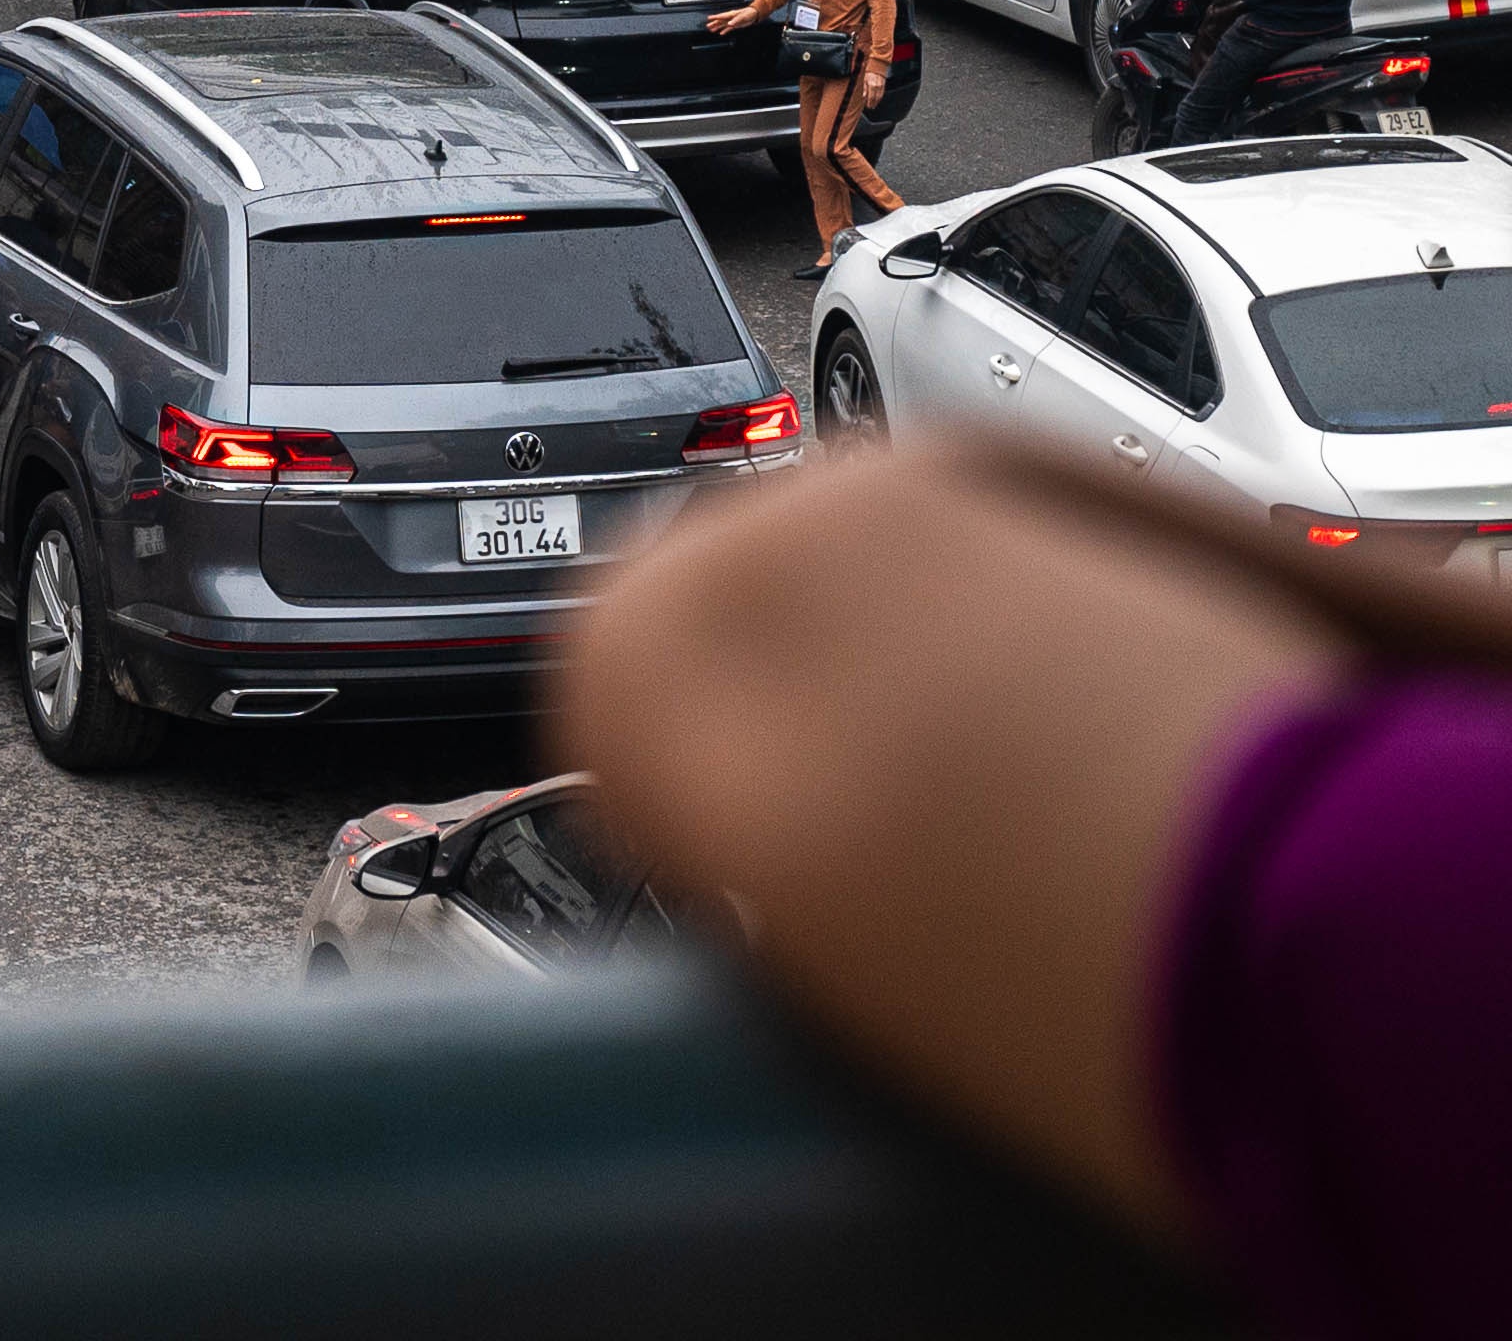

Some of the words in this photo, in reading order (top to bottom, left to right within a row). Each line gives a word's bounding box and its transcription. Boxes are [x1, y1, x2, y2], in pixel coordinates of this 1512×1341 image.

[1383, 111, 1426, 132] 29-E2
[494, 498, 545, 526] 30G
[476, 526, 568, 557] 301.44
